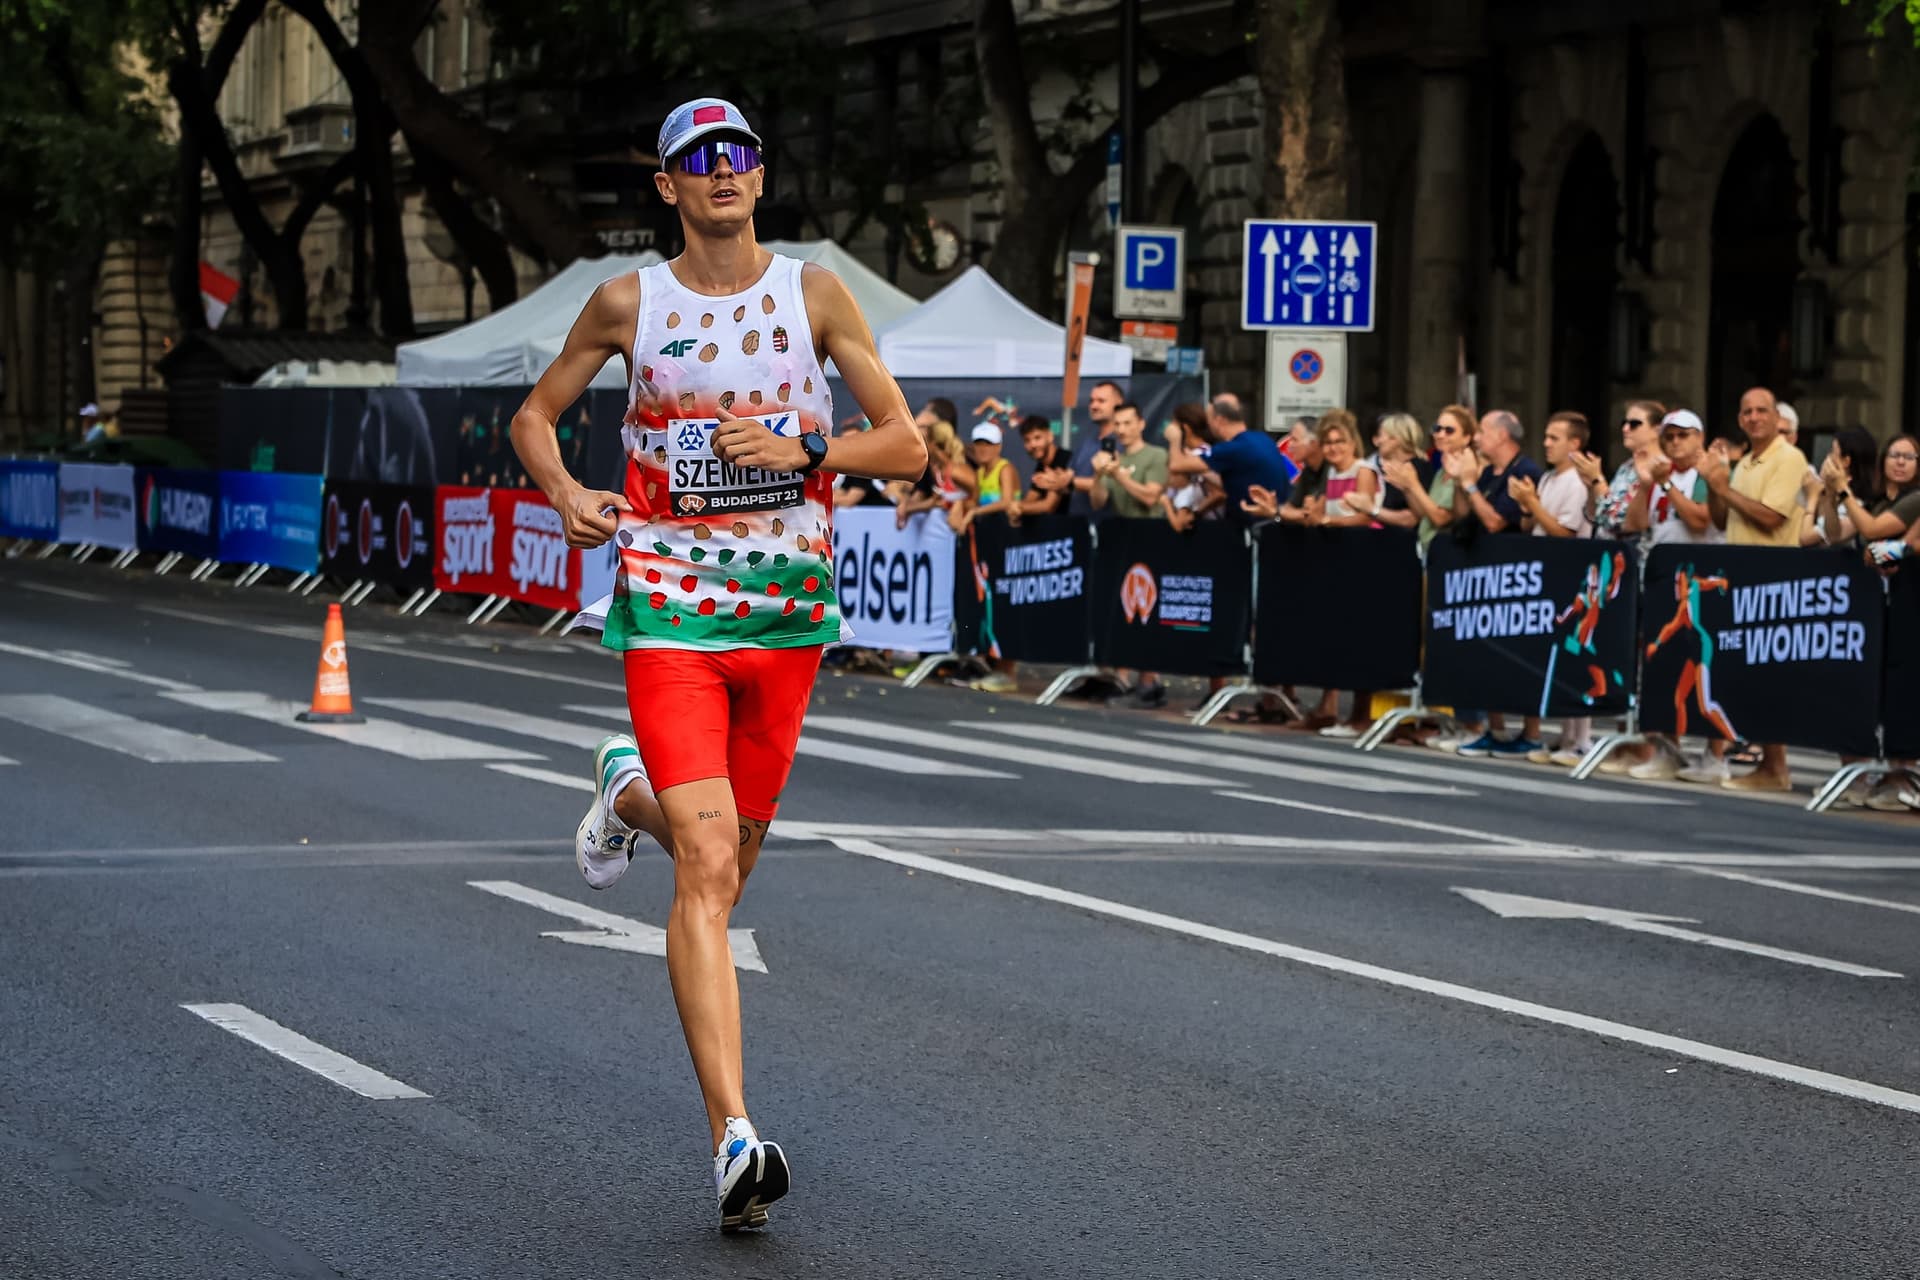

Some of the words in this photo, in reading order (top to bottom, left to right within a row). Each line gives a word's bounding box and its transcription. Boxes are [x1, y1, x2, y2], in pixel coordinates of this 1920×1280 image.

[1137, 242, 1164, 282] P
[660, 339, 698, 357] 4F
[711, 492, 783, 508] BUDAPEST
[784, 489, 798, 501] 23
[443, 514, 495, 585] sport
[510, 527, 569, 594] sport
[1005, 538, 1073, 575] WITNESS
[833, 531, 933, 625] ielsen
[1010, 566, 1083, 605] WONDER
[1445, 561, 1543, 604] WITNESS
[1732, 574, 1850, 624] WITNESS
[1432, 609, 1453, 629] THE
[1455, 600, 1555, 640] WONDER
[1717, 628, 1743, 650] THE
[1745, 621, 1866, 665] WONDER
[698, 810, 721, 820] Run
